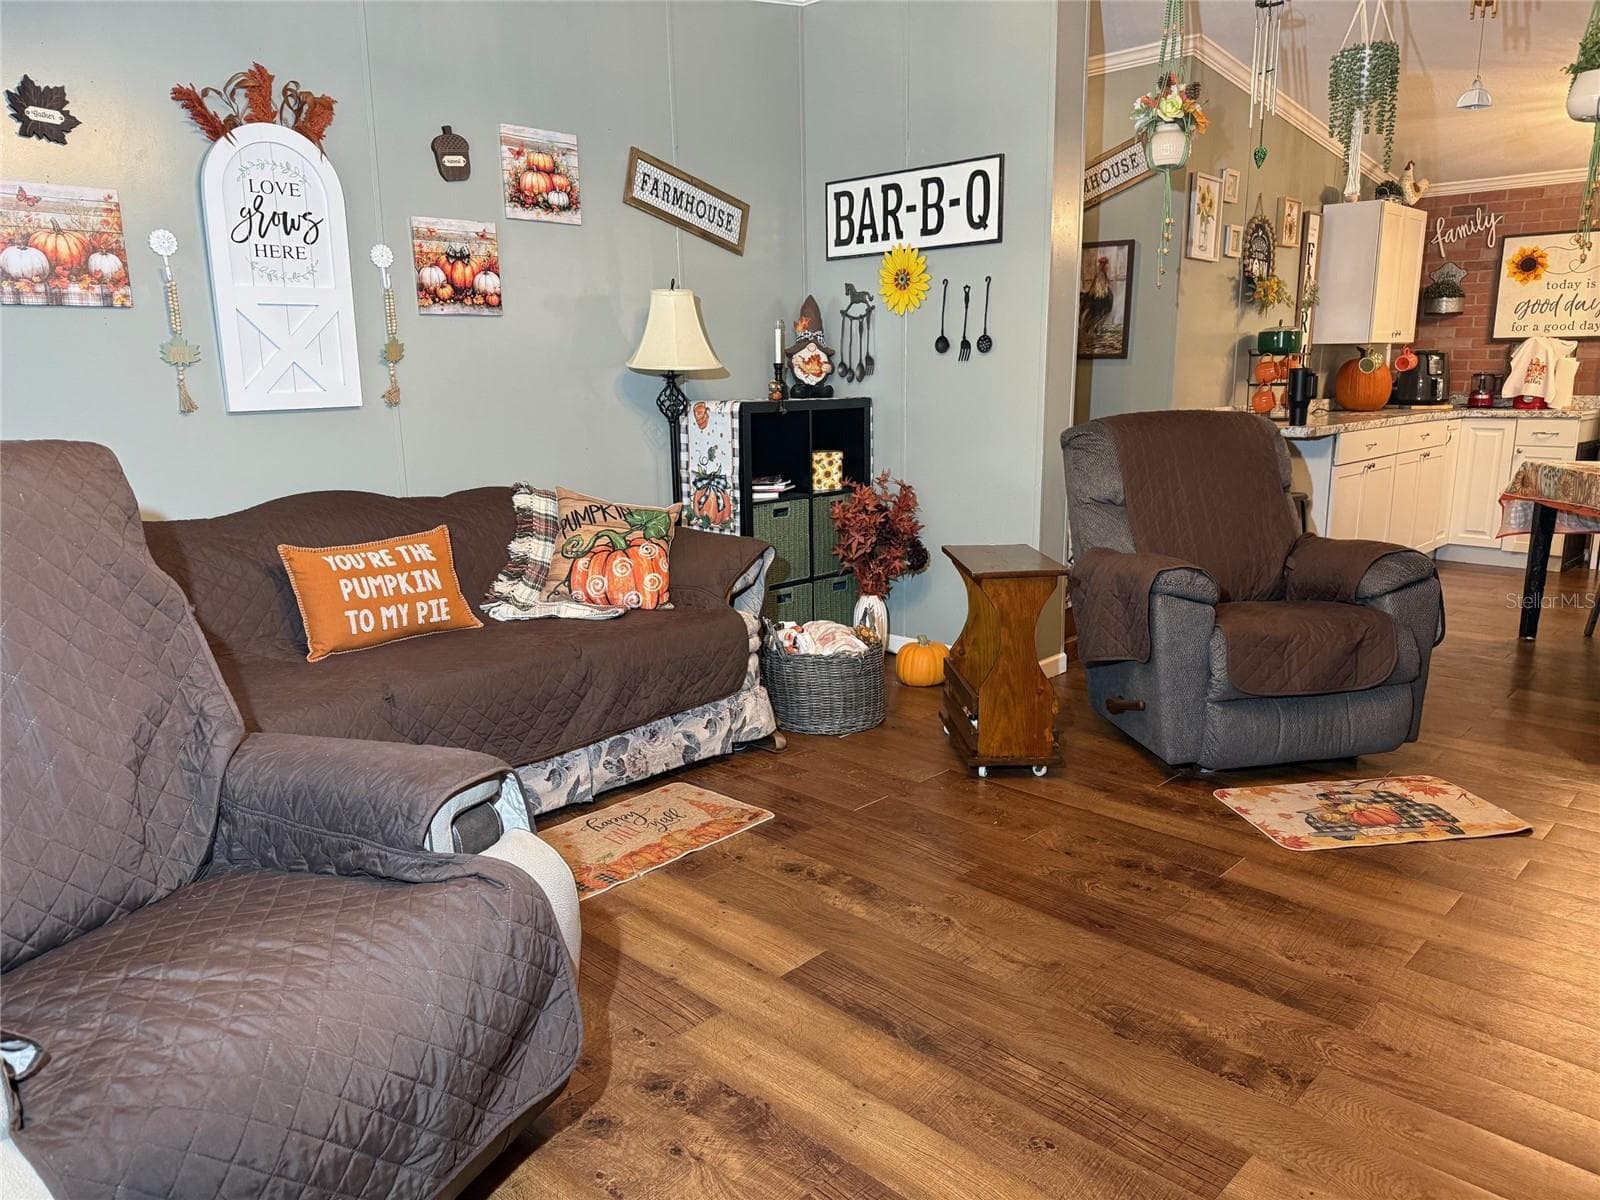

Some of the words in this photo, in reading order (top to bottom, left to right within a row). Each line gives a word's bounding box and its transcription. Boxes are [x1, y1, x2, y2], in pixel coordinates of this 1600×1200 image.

[248, 178, 302, 197] LOVE
[640, 172, 734, 233] FARMHOUSE
[230, 194, 324, 245] grows
[834, 169, 991, 247] BAR-B-Q
[1431, 207, 1503, 258] family
[254, 243, 307, 260] HERE
[1546, 279, 1582, 291] today
[1586, 278, 1597, 289] is
[1513, 293, 1563, 320] good
[1511, 321, 1529, 332] for
[1544, 321, 1575, 333] good
[1579, 320, 1600, 332] day
[560, 504, 635, 539] PUMPKIN
[321, 548, 397, 572] YOU'RE
[394, 543, 437, 564] THE
[338, 568, 443, 602] PUMPKIN
[344, 608, 376, 635] TO
[380, 602, 409, 631] MY
[415, 597, 451, 625] PIE
[580, 807, 651, 832] happy
